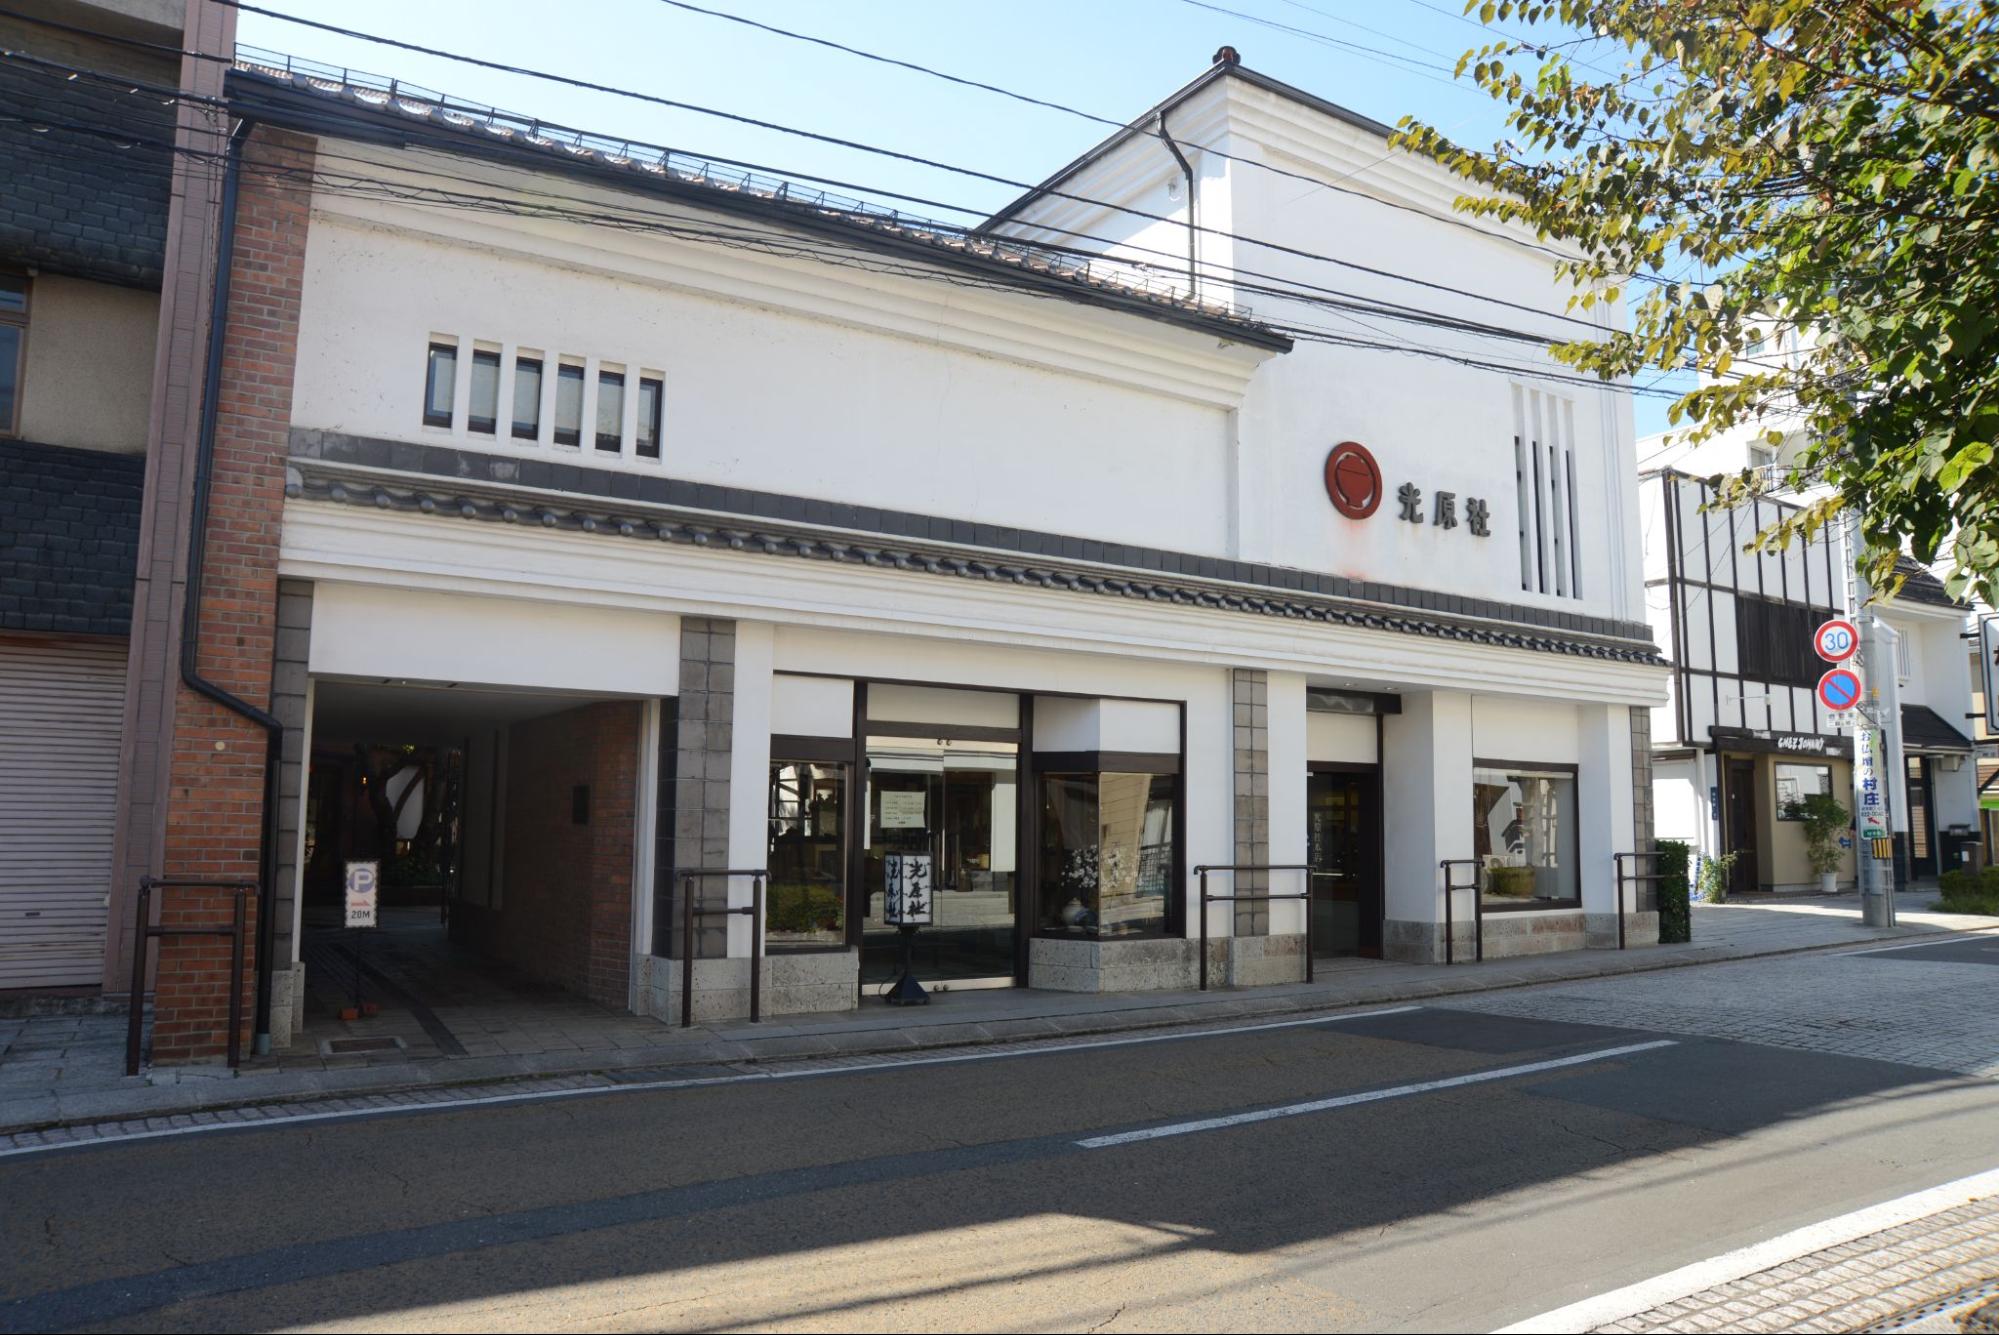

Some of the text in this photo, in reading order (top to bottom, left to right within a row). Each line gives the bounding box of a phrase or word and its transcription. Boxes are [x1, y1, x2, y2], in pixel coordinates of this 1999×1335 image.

[1397, 481, 1491, 537] 光原社
[1825, 632, 1849, 651] 30
[354, 871, 373, 891] P
[906, 857, 928, 921] 光原社
[351, 910, 370, 919] 20M
